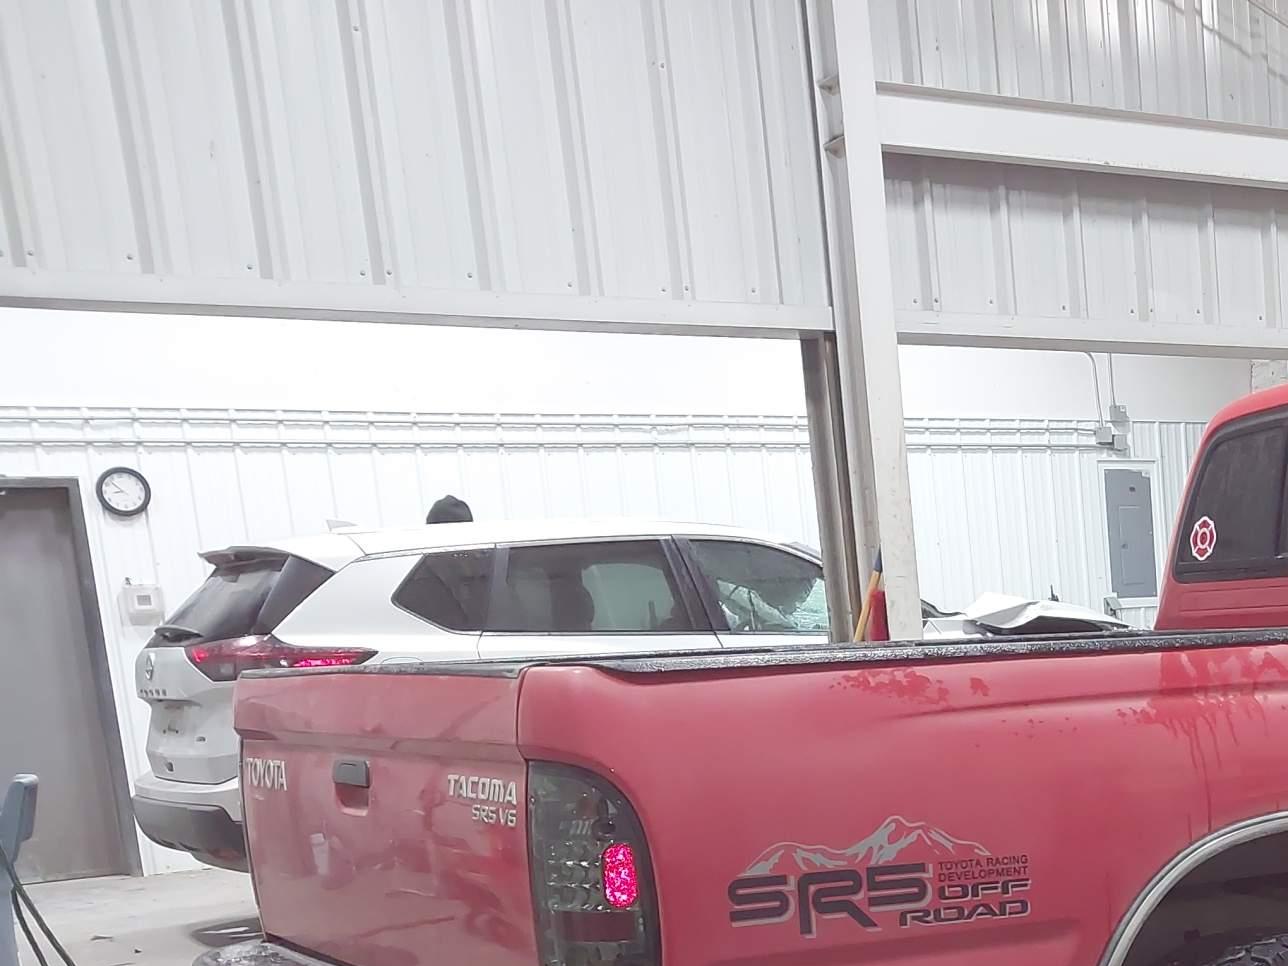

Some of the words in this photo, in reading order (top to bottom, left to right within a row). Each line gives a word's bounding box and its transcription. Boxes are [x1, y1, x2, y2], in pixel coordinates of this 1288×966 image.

[246, 757, 288, 791] TOYOTA
[447, 774, 518, 806] TACOMA
[498, 807, 517, 828] V6
[937, 865, 1029, 883] DEVELOPMENT
[938, 859, 983, 872] TOYOTA
[986, 854, 1029, 868] RACING
[727, 862, 933, 938] SR5
[938, 878, 1032, 903] OFF
[899, 899, 1031, 929] ROAD
